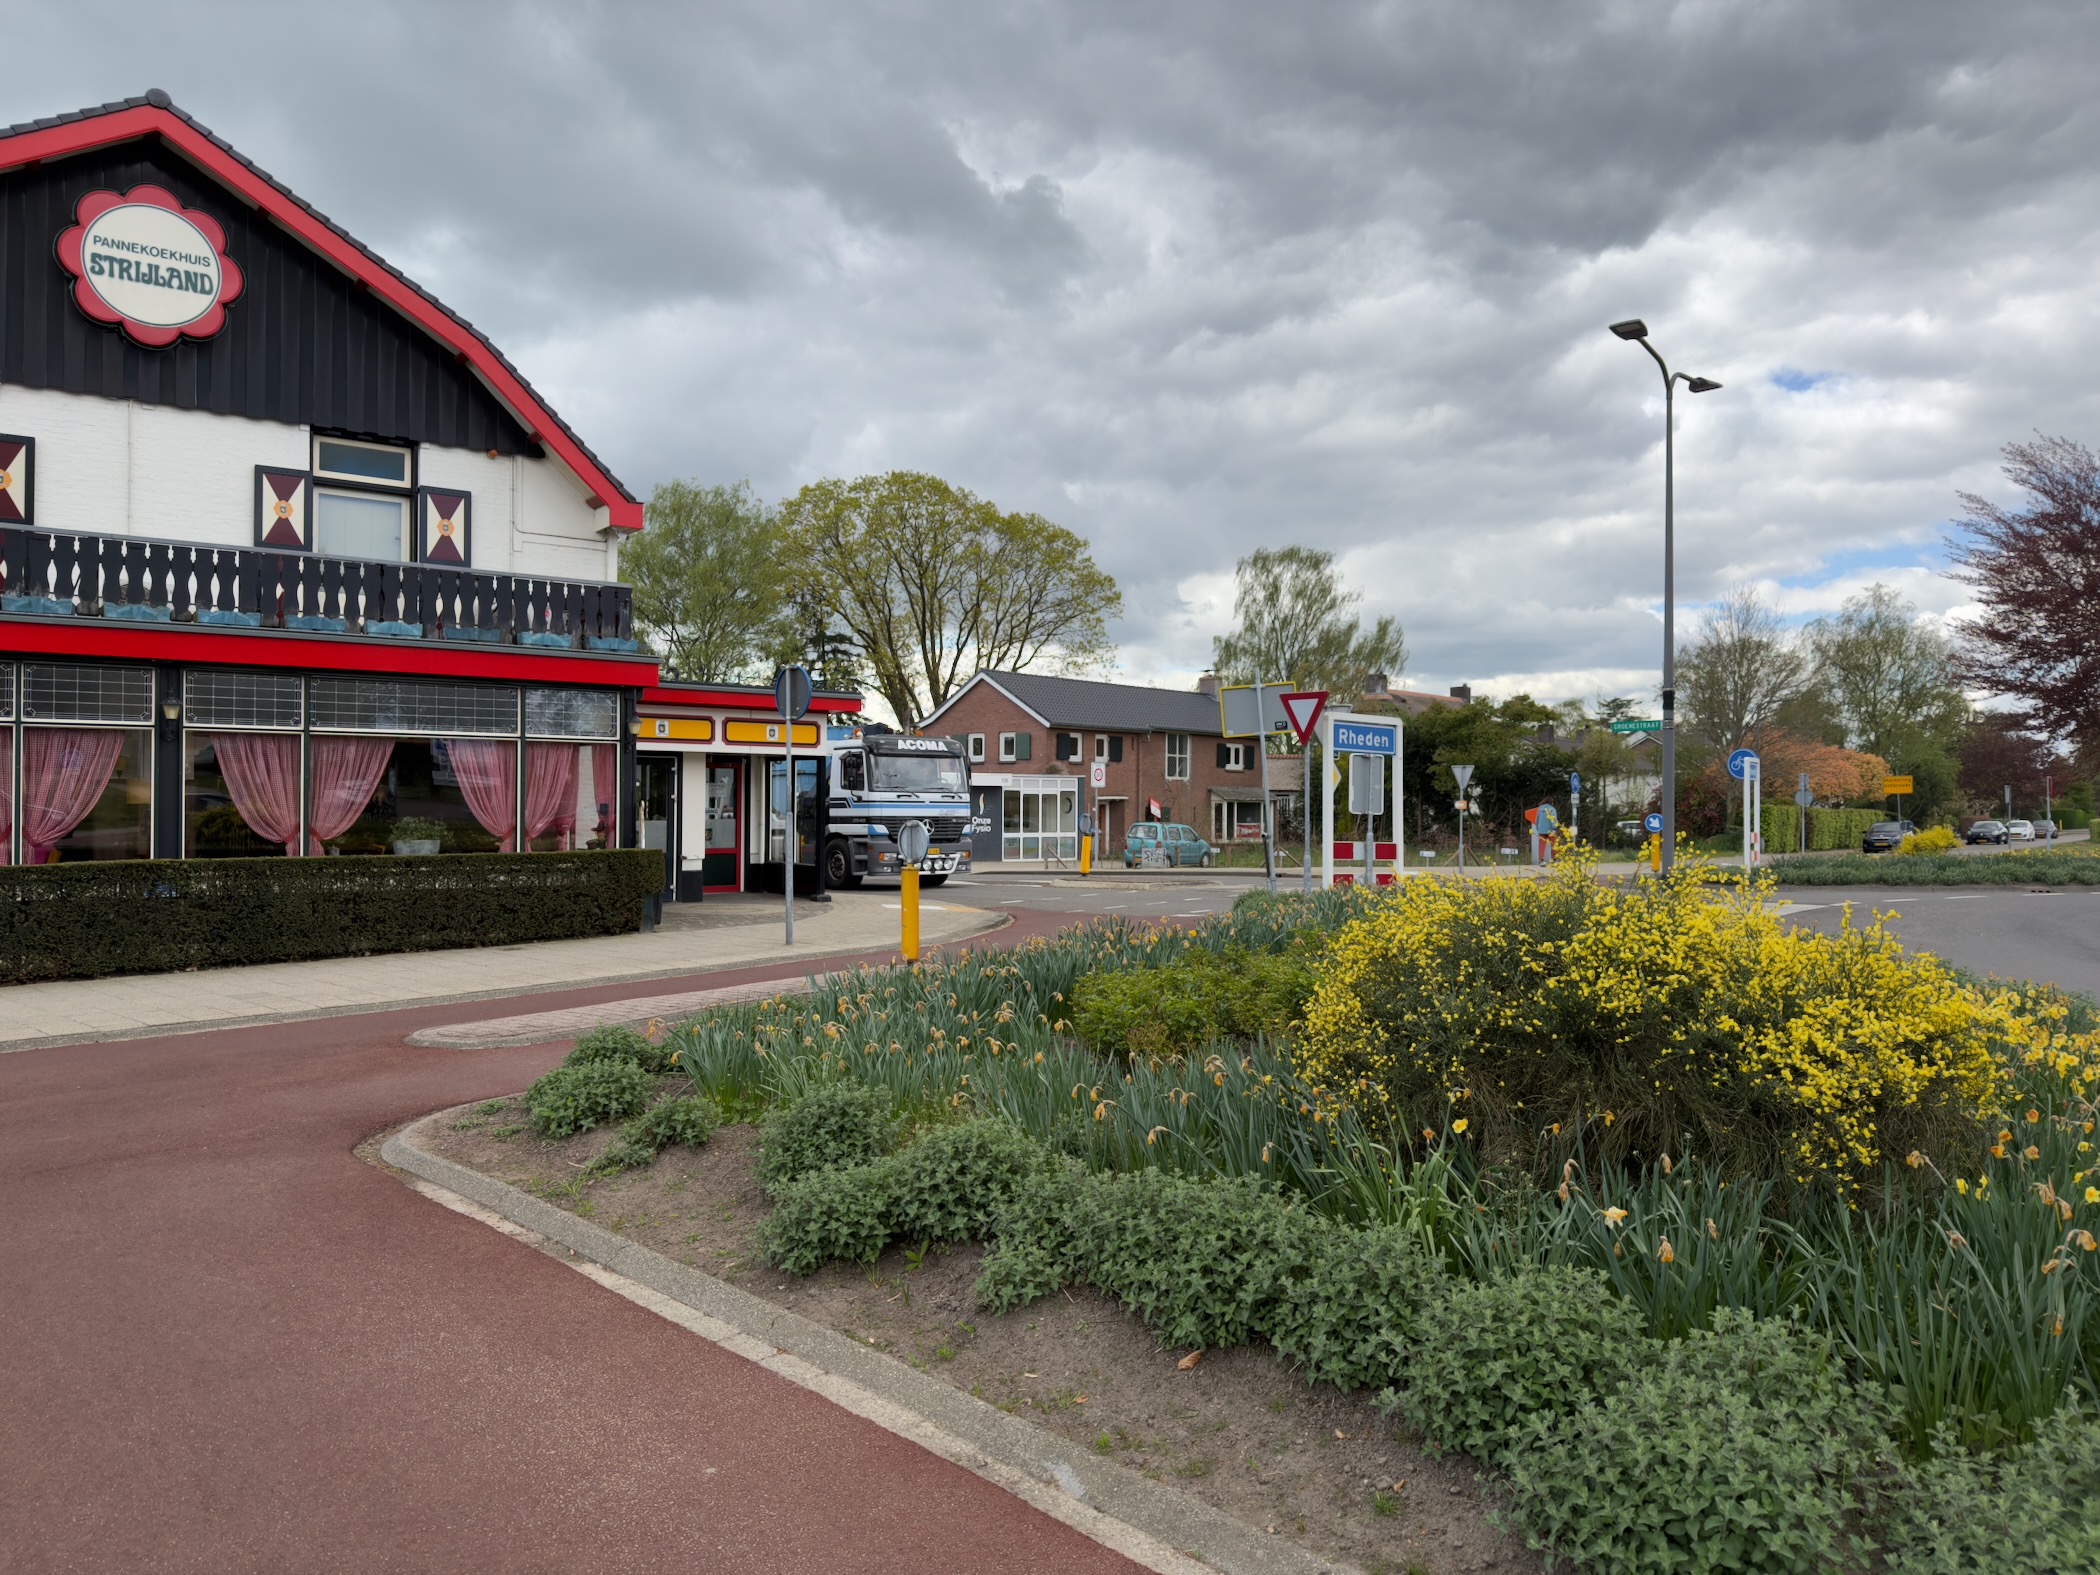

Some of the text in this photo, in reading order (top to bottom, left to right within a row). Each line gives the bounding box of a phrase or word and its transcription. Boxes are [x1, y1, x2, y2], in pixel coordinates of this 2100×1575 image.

[93, 235, 211, 267] PANNEKOEKHUIS
[89, 252, 214, 296] STRIJLAND
[1613, 721, 1659, 730] GROENESTRAAT
[1338, 728, 1389, 748] Rheden
[897, 739, 949, 751] ACOMA
[971, 816, 992, 825] Onze
[971, 824, 992, 834] Fysio
